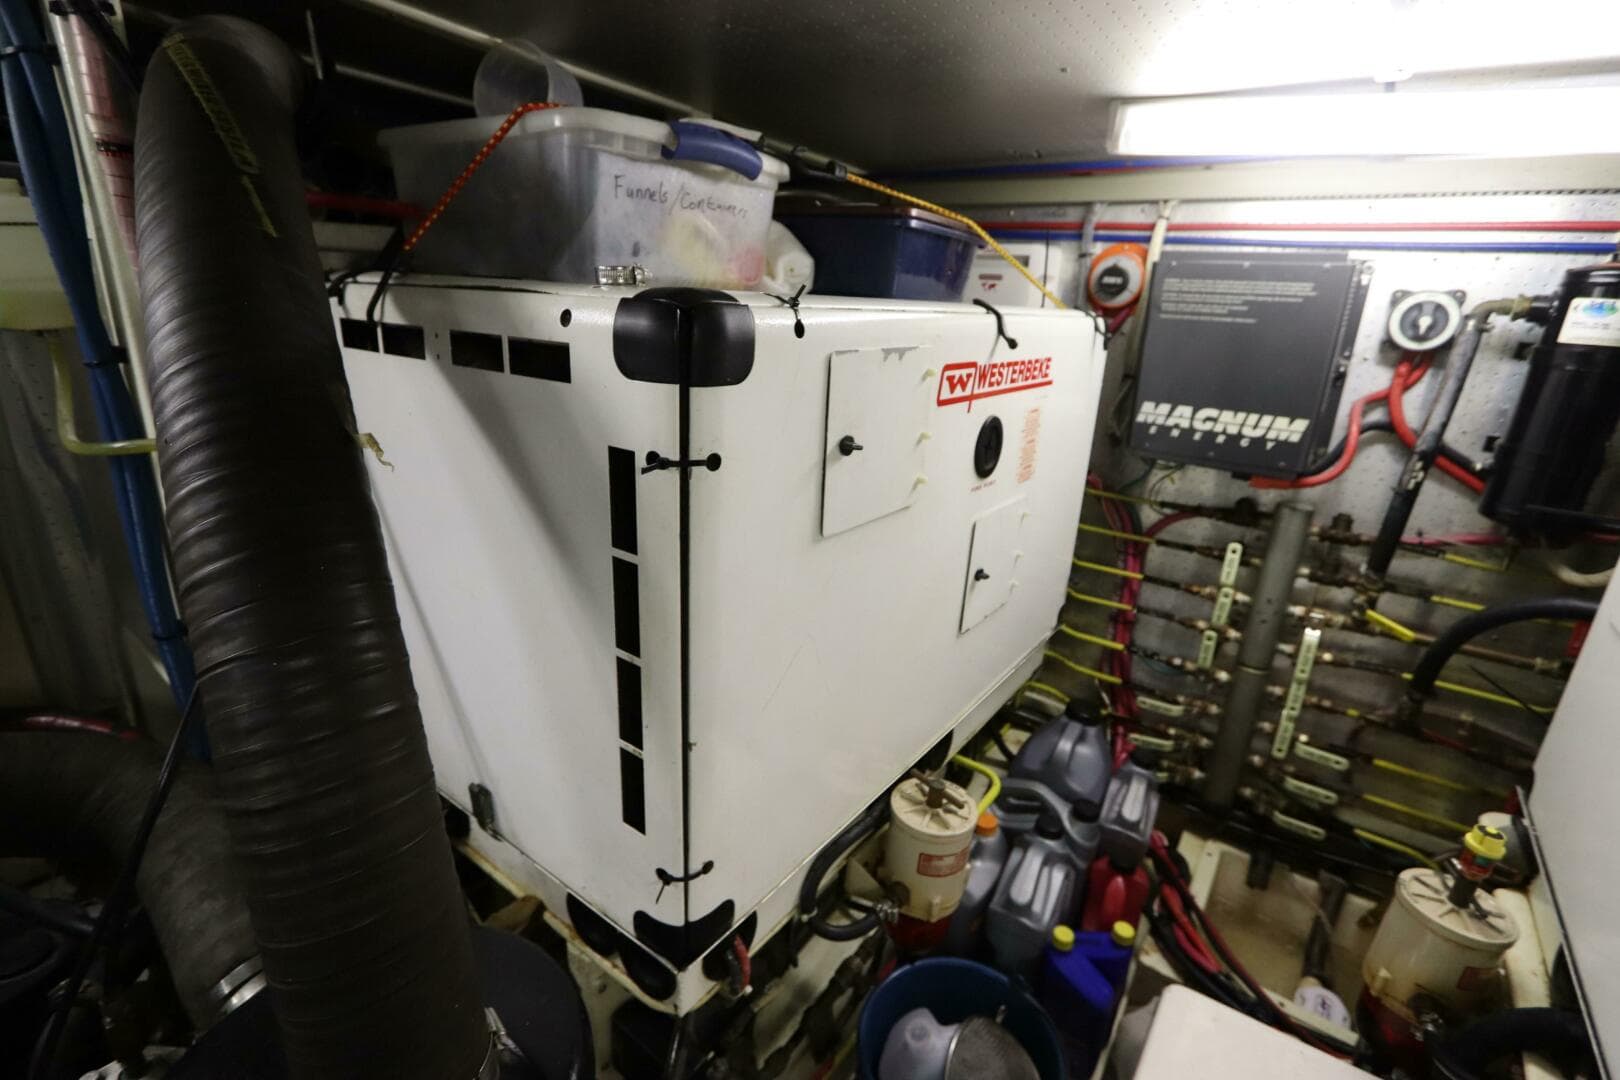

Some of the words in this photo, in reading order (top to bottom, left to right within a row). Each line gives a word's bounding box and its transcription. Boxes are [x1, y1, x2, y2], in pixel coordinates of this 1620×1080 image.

[946, 373, 972, 394] W
[977, 357, 1052, 389] WESTERBEKE
[1135, 400, 1310, 443] MAGNUM
[1148, 425, 1276, 451] ENERGY
